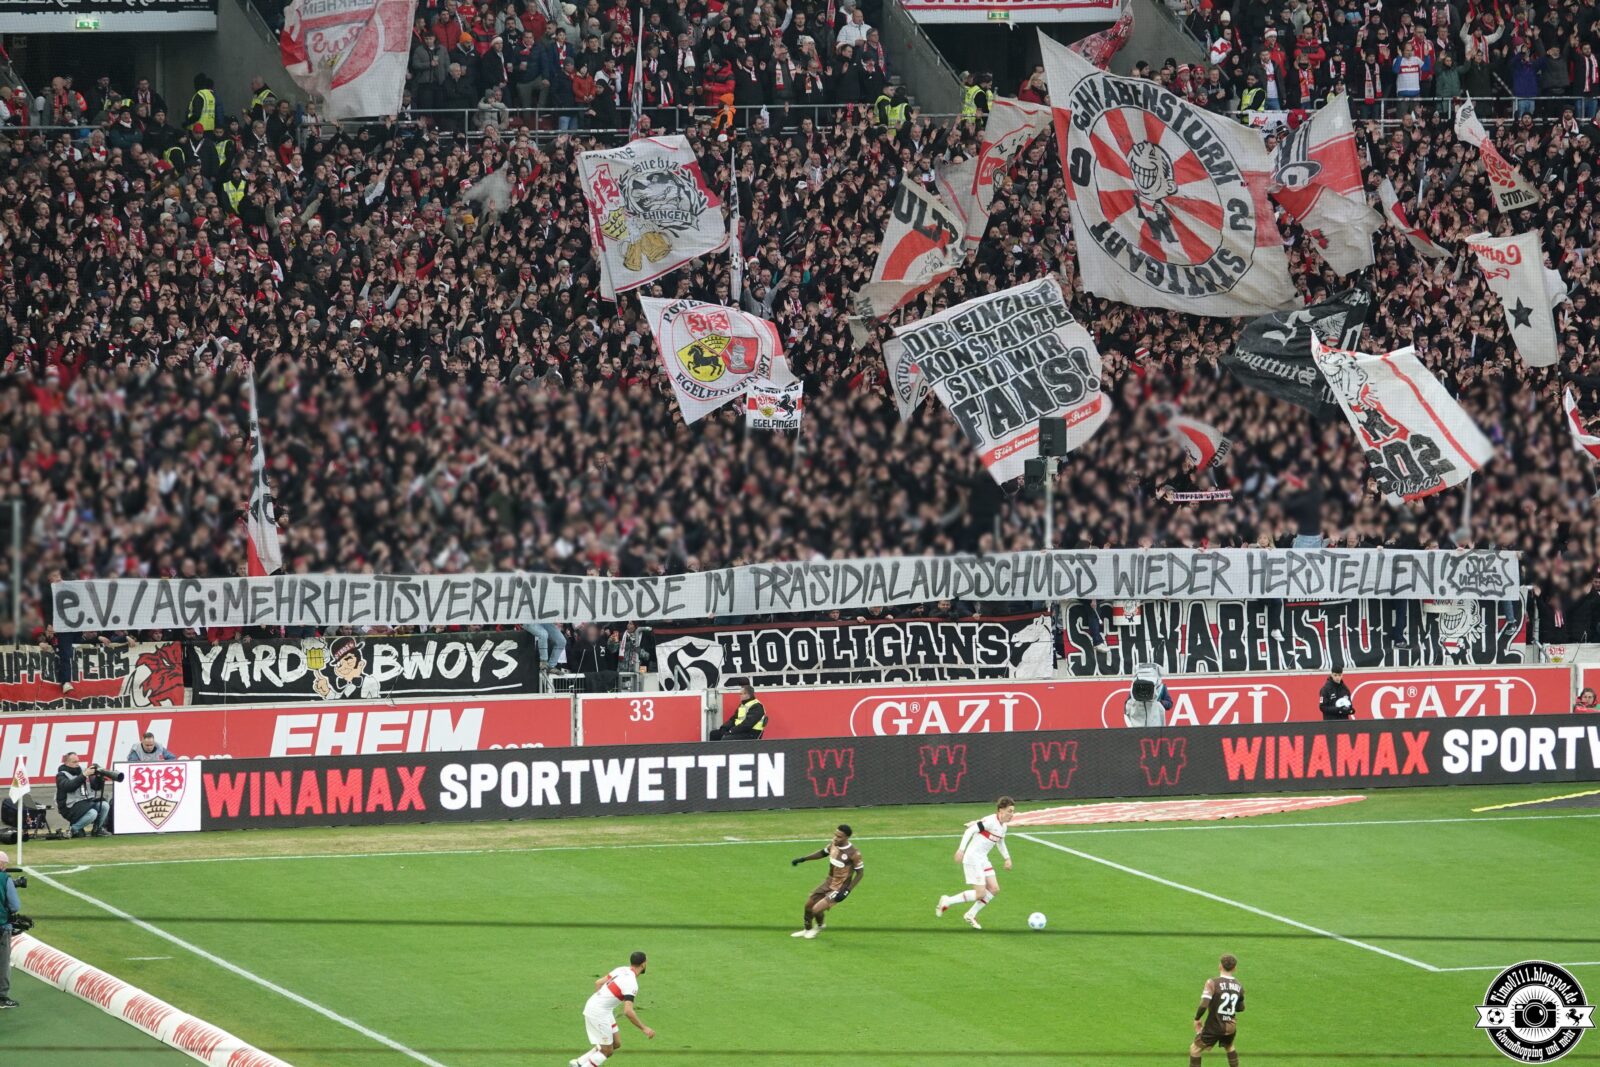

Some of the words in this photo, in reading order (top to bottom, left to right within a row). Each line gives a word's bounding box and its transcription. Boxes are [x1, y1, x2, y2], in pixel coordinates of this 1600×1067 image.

[1090, 220, 1246, 297] STUTTGART
[901, 323, 956, 359] DIE
[951, 280, 1059, 338] EINZIGE
[918, 304, 1074, 384] KONSTANTE
[947, 356, 1008, 402] SIND
[1007, 333, 1067, 373] WIR
[950, 347, 1100, 448] FANS!
[1014, 431, 1040, 449] imme
[705, 568, 735, 614] IM
[750, 552, 1098, 611] PRÄSIDIALAUSSCHUSS
[1112, 552, 1233, 597] WIEDER
[1246, 549, 1451, 598] HERSTELLEN!
[194, 643, 307, 688] YARD
[371, 639, 519, 683] BWOYS
[715, 622, 1010, 675] HOOLIGANS
[269, 707, 485, 758] EHEIM
[629, 699, 655, 721] 33
[0, 718, 172, 779] HEIM
[1222, 730, 1431, 781] WINAMAX
[202, 765, 427, 818] WINAMAX
[439, 751, 785, 810] SPORTWETTEN
[1217, 992, 1238, 1016] 23
